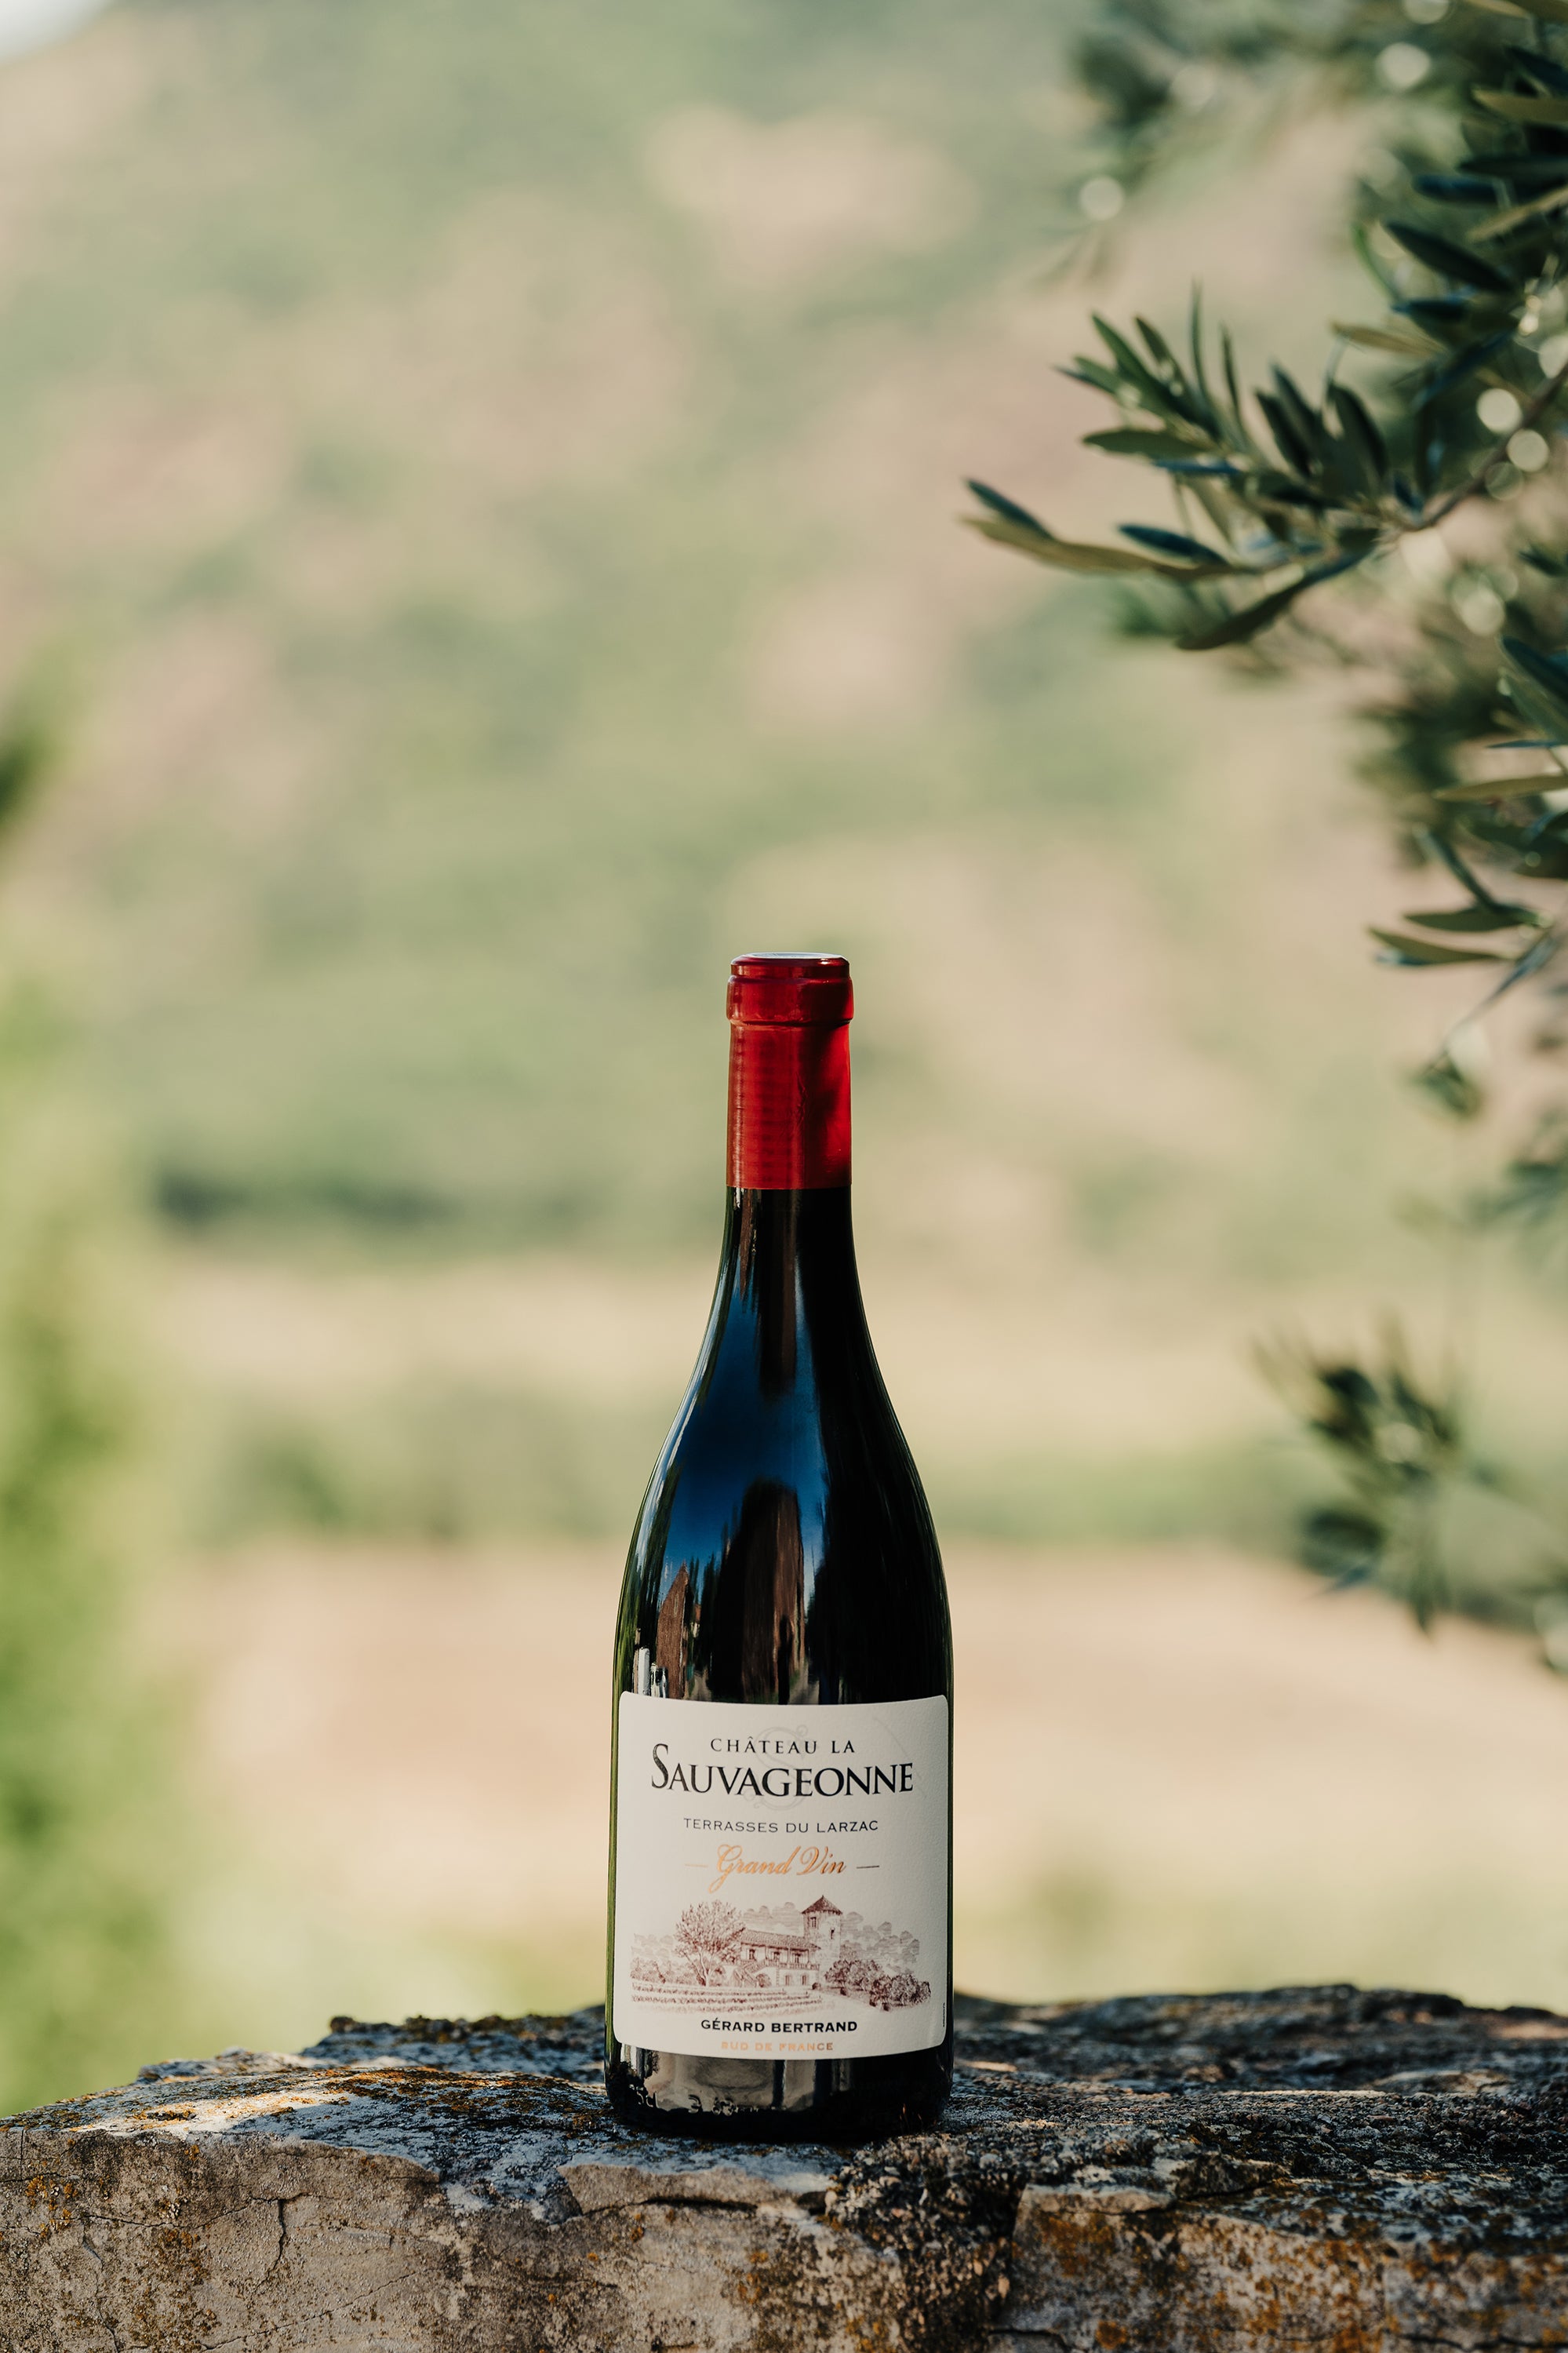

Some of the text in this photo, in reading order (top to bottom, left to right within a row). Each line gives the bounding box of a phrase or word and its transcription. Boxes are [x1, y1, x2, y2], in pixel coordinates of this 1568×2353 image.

[710, 1736, 855, 1754] CHÂTEAU LA
[651, 1742, 914, 1798] SAUVAGEONNE
[684, 1818, 879, 1834] TERRASSES DU LARZAC
[708, 1844, 846, 1894] Grand Vin
[700, 2017, 858, 2033] GÉRARD BERTRAND
[755, 2042, 773, 2051] DE
[779, 2042, 834, 2052] FRANCE
